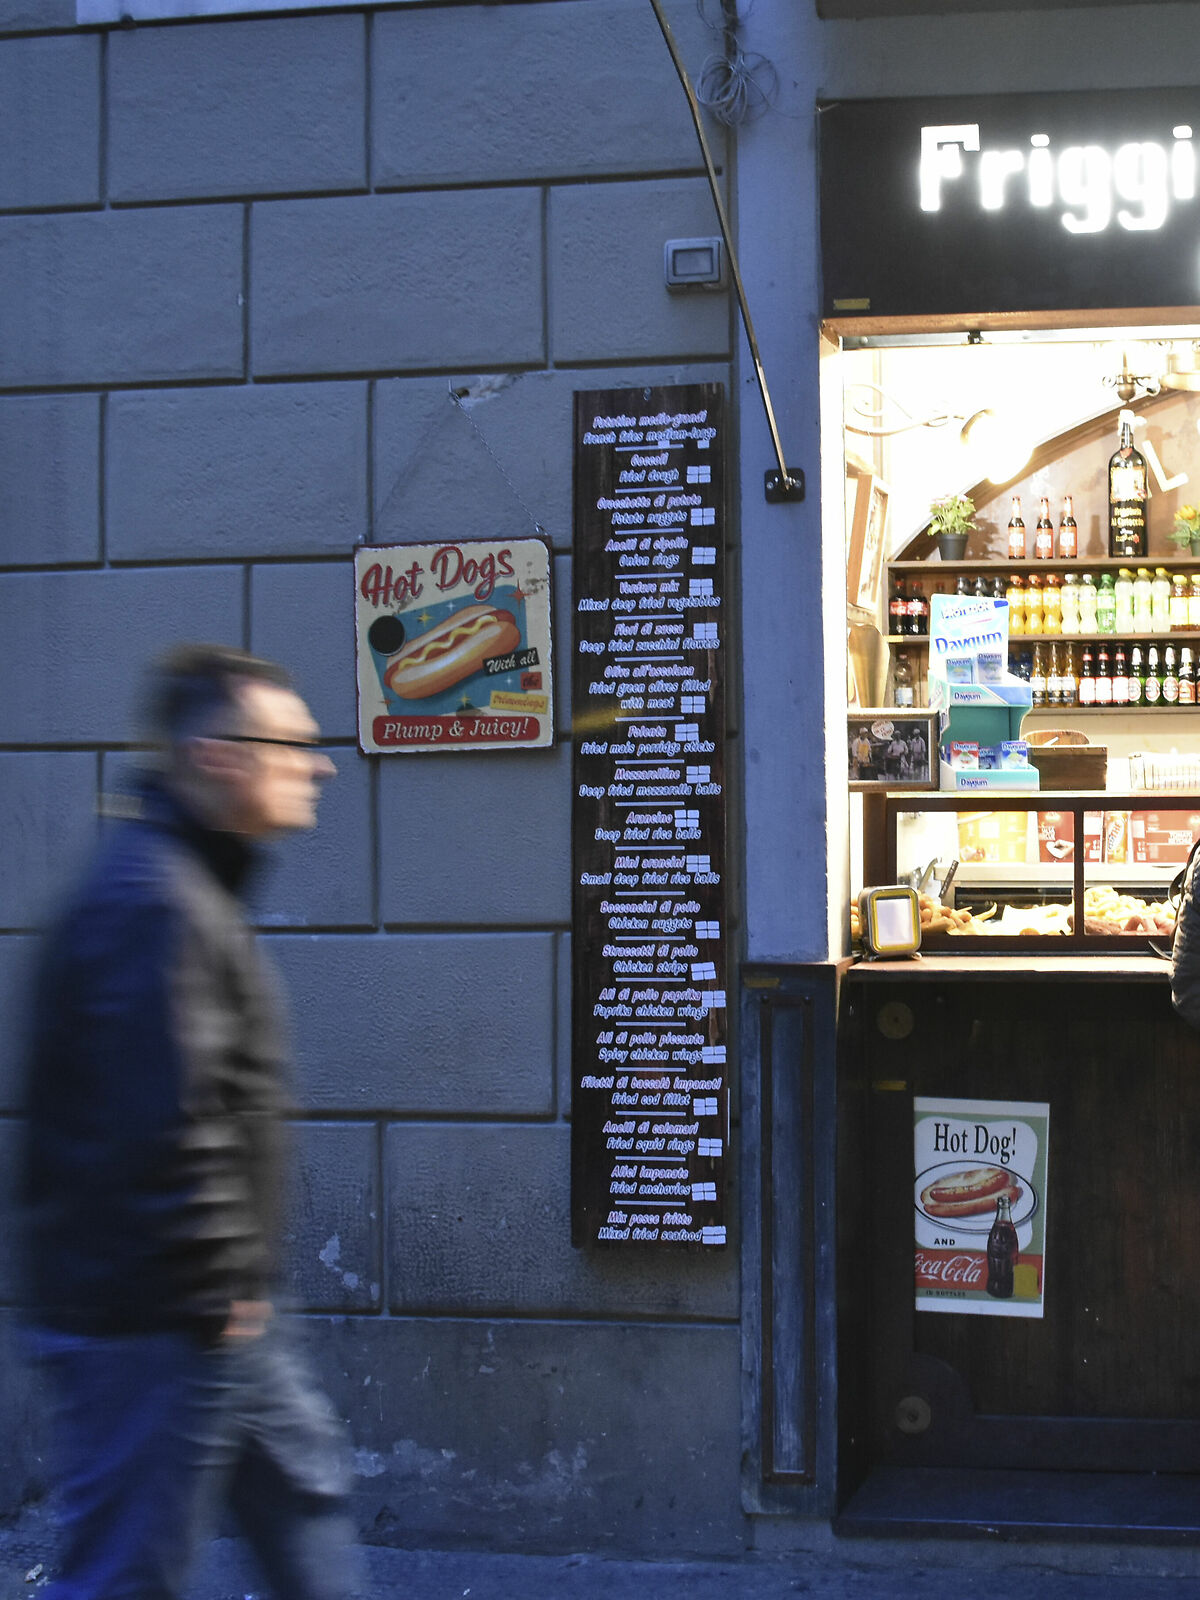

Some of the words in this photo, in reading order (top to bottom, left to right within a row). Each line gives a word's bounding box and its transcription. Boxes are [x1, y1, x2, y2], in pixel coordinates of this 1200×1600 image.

[639, 537, 651, 550] di
[361, 561, 425, 607] Hot
[430, 546, 515, 601] Dogs
[641, 622, 653, 635] di
[486, 655, 516, 673] With
[519, 650, 537, 665] all
[382, 722, 443, 740] Plump
[448, 720, 465, 737] &
[469, 717, 530, 738] Juicy!
[960, 778, 988, 787] Daygum
[579, 784, 605, 800] Deep
[608, 784, 634, 796] fried
[595, 828, 620, 843] Deep
[624, 827, 650, 840] fried
[676, 827, 702, 839] balls
[615, 856, 640, 869] Mini
[580, 872, 612, 885] Small
[614, 872, 639, 887] deep
[642, 872, 668, 885] fried
[670, 872, 691, 885] rice
[694, 872, 720, 885] balls
[660, 901, 672, 913] di
[673, 901, 701, 916] pollo
[608, 916, 648, 929] Chicken
[652, 917, 692, 932] nuggets
[657, 944, 670, 957] di
[671, 944, 698, 959] pollo
[613, 960, 653, 973] Chicken
[656, 960, 688, 976] strips
[618, 988, 630, 1000] di
[632, 988, 659, 1003] pollo
[661, 988, 701, 1003] paprika
[593, 1004, 632, 1019] Paprika
[636, 1004, 674, 1016] chicken
[678, 1004, 708, 1020] wings
[616, 1031, 628, 1044] di
[629, 1032, 656, 1047] pollo
[598, 1047, 628, 1063] Spicy
[630, 1048, 669, 1060] chicken
[672, 1048, 702, 1064] wings
[616, 1076, 628, 1089] di
[611, 1092, 639, 1105] Fried
[641, 1093, 660, 1105] cod
[638, 1121, 650, 1134] di
[606, 1137, 634, 1149] Fried
[636, 1138, 665, 1153] squid
[667, 1138, 695, 1154] rings
[934, 1122, 969, 1153] Hot
[974, 1124, 1017, 1165] Dog!
[610, 1181, 637, 1193] Fried
[639, 1182, 690, 1195] anchovies
[598, 1227, 630, 1240] Mixed
[632, 1227, 659, 1240] fried
[661, 1229, 702, 1241] seafood
[933, 1238, 956, 1246] AND
